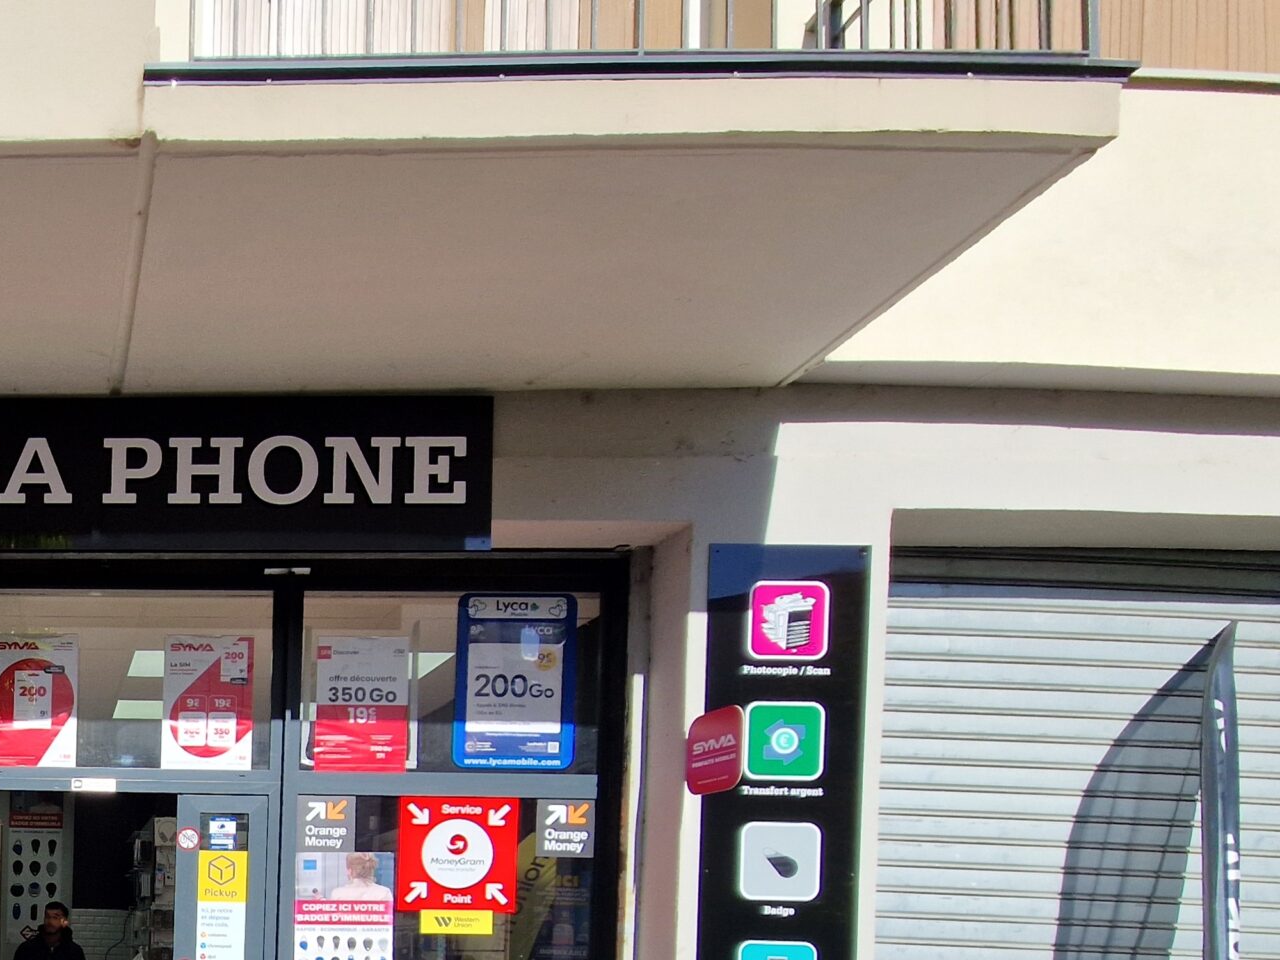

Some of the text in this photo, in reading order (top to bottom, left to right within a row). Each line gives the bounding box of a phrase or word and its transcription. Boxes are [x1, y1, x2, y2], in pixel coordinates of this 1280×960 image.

[102, 435, 467, 504] PHONE
[496, 600, 528, 613] Lyca
[170, 643, 214, 652] SYMA
[742, 665, 798, 677] Photocopie
[806, 666, 831, 675] Scan
[350, 674, 397, 682] découverte
[19, 686, 47, 697] 200
[692, 734, 736, 755] SYMA
[464, 758, 561, 766] www.lycamobile.com
[741, 785, 824, 798] Transfert argent
[441, 804, 483, 815] Service
[305, 825, 347, 837] Orange
[545, 829, 589, 841] Orange
[305, 837, 343, 849] Money
[544, 840, 584, 853] Money
[430, 857, 485, 867] MoneyGram
[204, 889, 238, 899] Pickup
[443, 894, 472, 904] Point
[763, 905, 795, 916] Badge
[296, 914, 391, 922] BADGE D'IMMEUBLE
